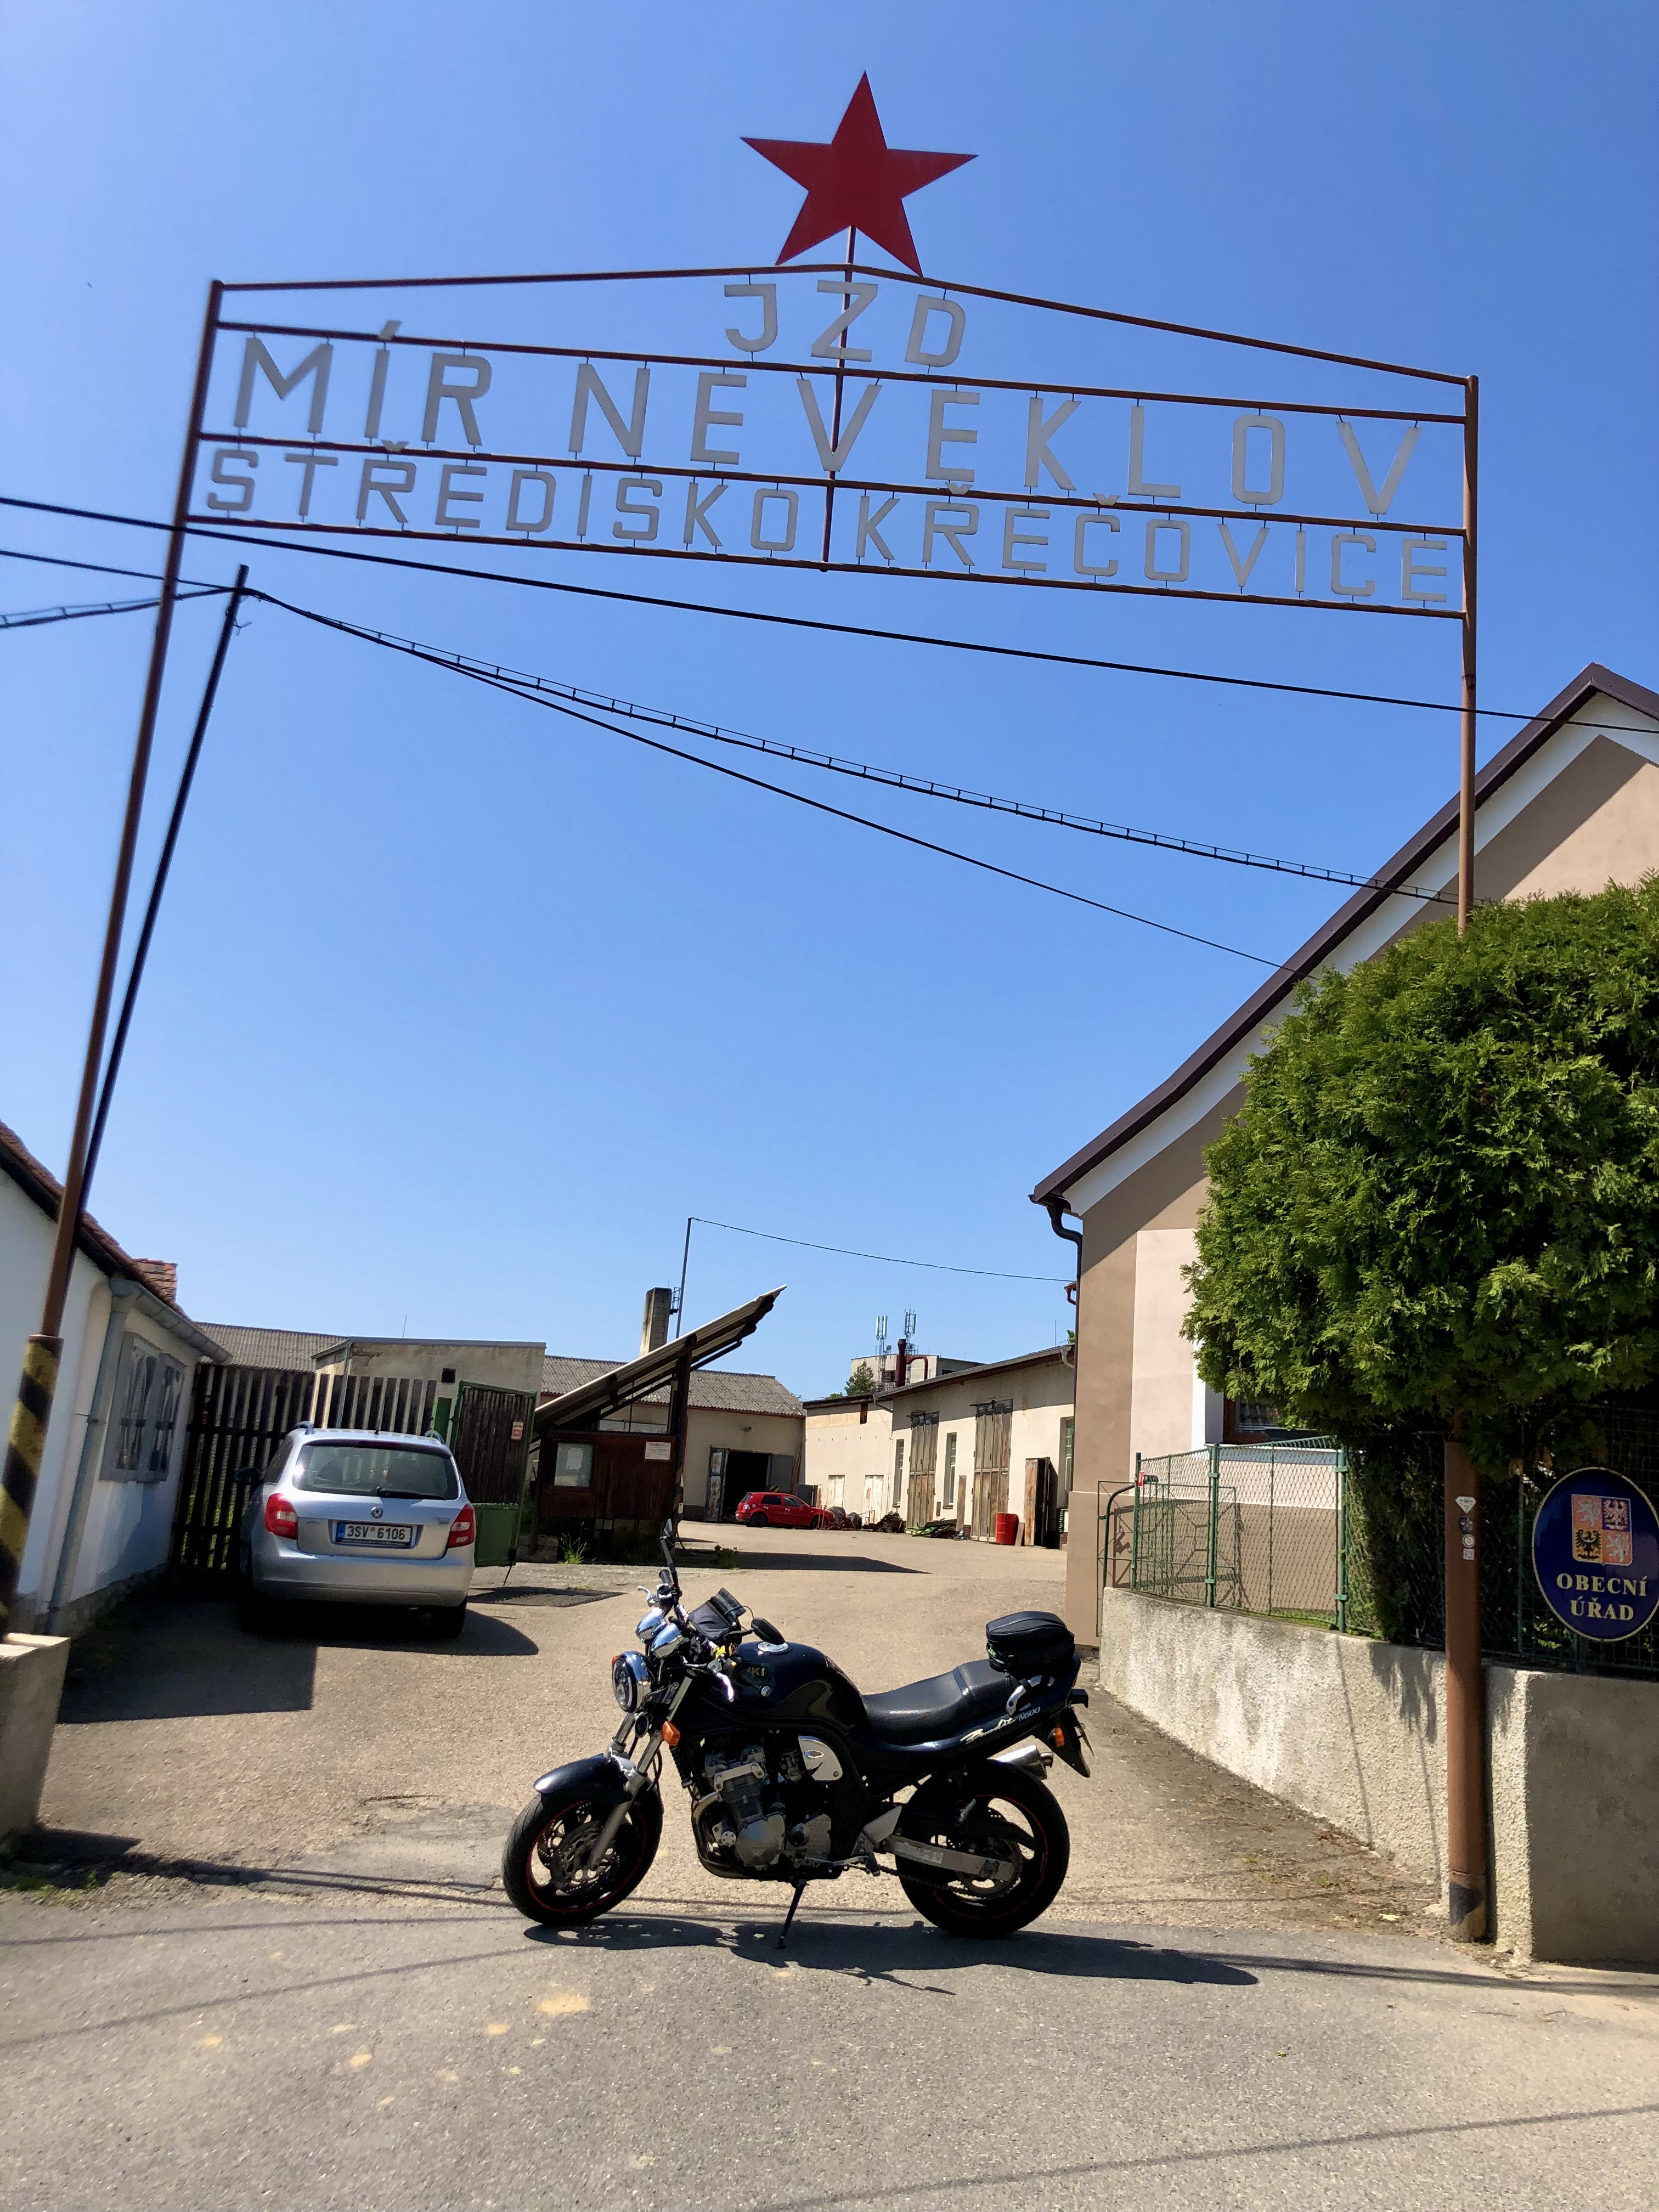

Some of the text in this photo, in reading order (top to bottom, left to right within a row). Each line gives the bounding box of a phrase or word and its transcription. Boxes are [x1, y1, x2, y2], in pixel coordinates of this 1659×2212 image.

[724, 280, 966, 367] JZD
[234, 320, 1422, 514] MÍR NEVEKLOV
[207, 440, 1447, 602] STŘEDISKO KŘEČOVICE
[347, 1526, 406, 1539] 3SV 6106
[1556, 1573, 1647, 1596] OBECNÍ
[1570, 1595, 1634, 1621] ÚŘAD
